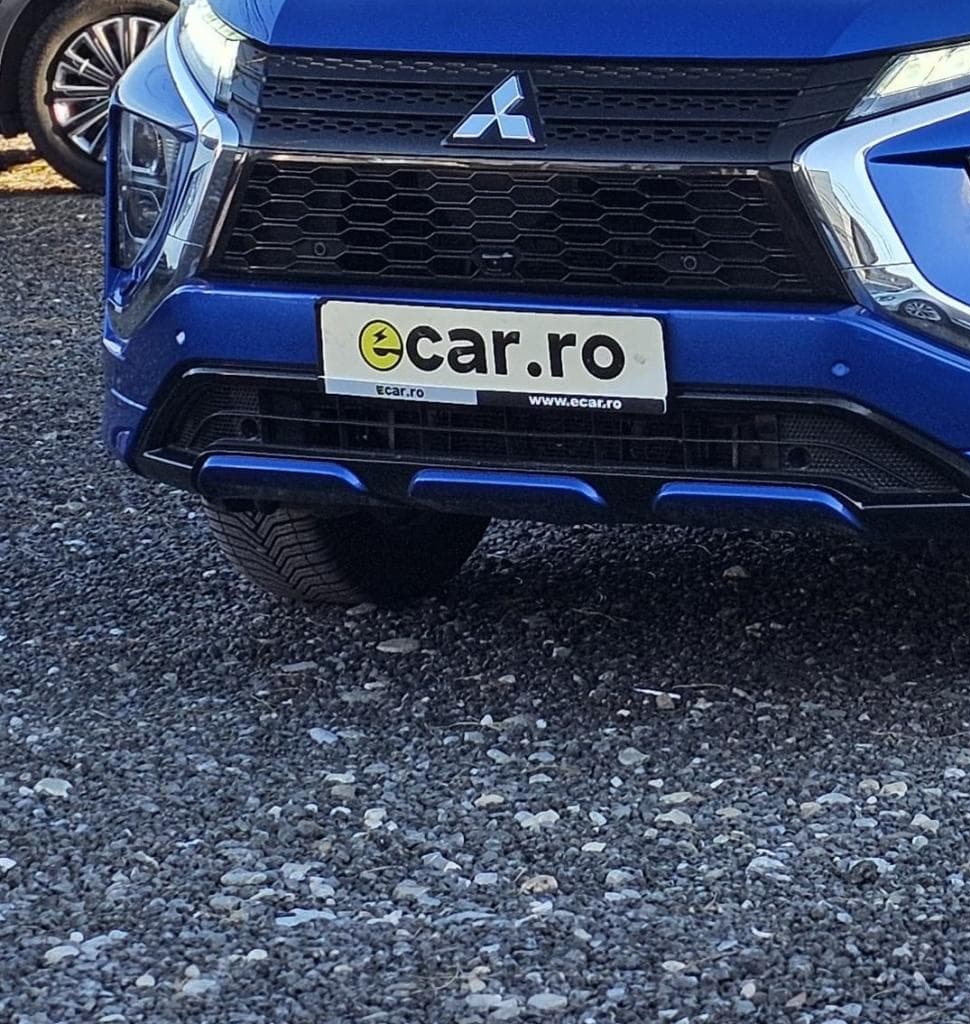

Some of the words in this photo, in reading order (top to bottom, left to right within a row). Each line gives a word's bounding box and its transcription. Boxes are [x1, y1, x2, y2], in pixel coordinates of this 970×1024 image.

[358, 319, 626, 380] ecar.ro
[376, 385, 425, 399] Ecar.ro
[528, 395, 622, 410] www.ecar.ro
